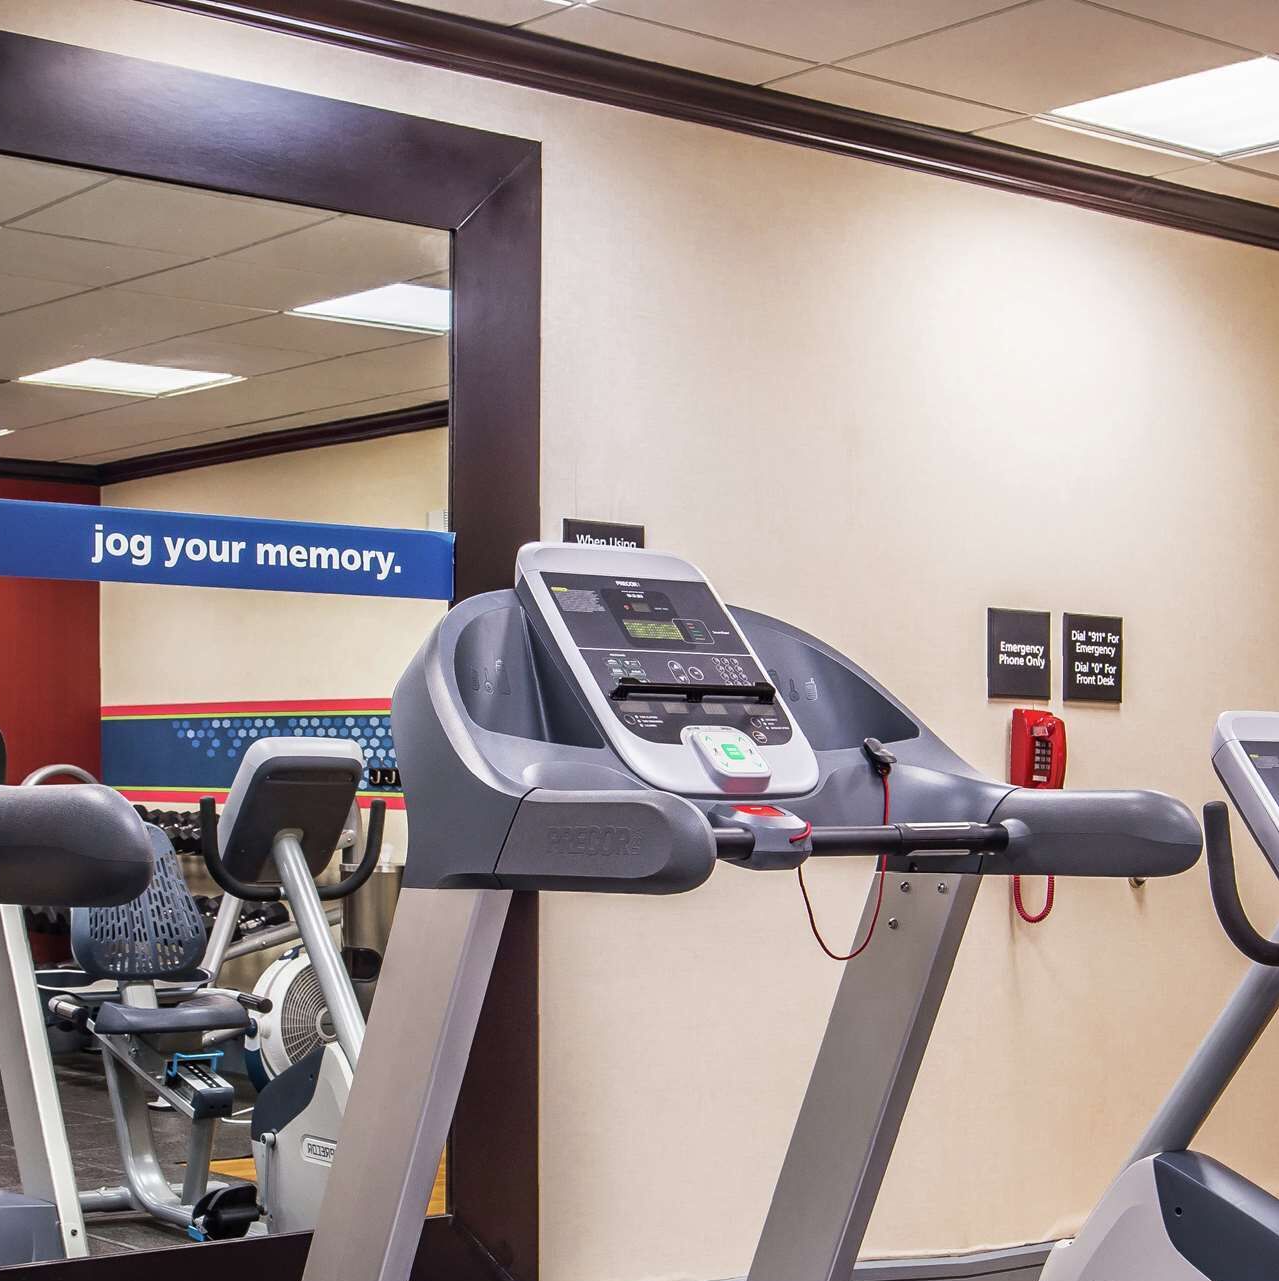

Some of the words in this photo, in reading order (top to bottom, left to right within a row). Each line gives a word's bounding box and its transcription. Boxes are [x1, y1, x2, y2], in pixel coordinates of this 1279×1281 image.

[576, 534, 607, 546] When
[91, 524, 152, 566] jog
[163, 535, 246, 568] your
[256, 541, 402, 580] memory.
[1071, 630, 1086, 641] Dial
[1088, 631, 1105, 642] "911"
[1107, 633, 1120, 644] For
[1000, 641, 1045, 657] Emergency
[1076, 642, 1116, 658] Emergency
[999, 654, 1024, 666] Phone
[1026, 656, 1045, 669] Only
[1074, 662, 1089, 673] Dial
[1091, 663, 1102, 673] "0"
[1104, 664, 1117, 674] For
[1076, 674, 1096, 685] Front
[1097, 675, 1115, 686] Desk
